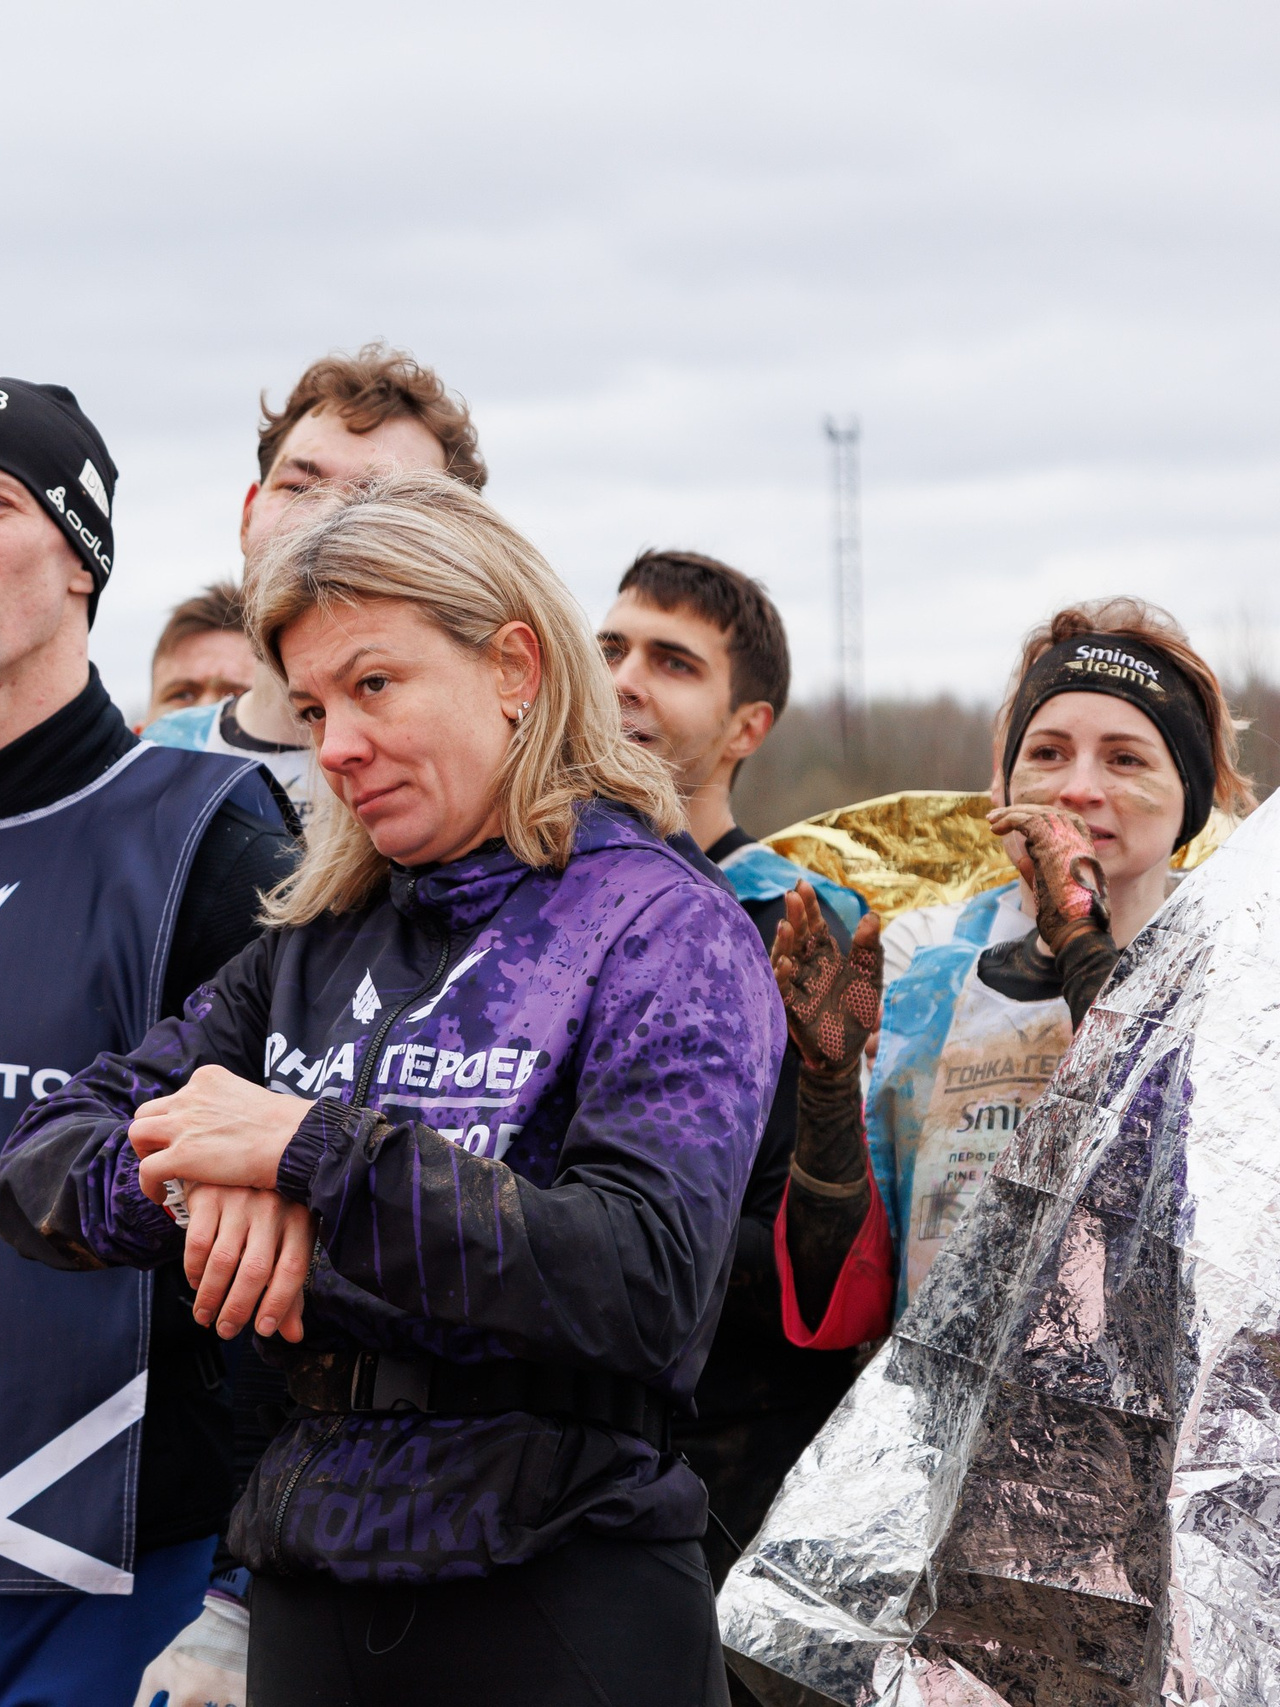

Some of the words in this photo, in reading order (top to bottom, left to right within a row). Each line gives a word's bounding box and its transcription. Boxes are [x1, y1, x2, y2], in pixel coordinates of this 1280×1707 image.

[1075, 645, 1160, 680] Sminex
[1086, 660, 1145, 684] team
[945, 1057, 1015, 1086] ГОНКА
[947, 1170, 976, 1181] FINE
